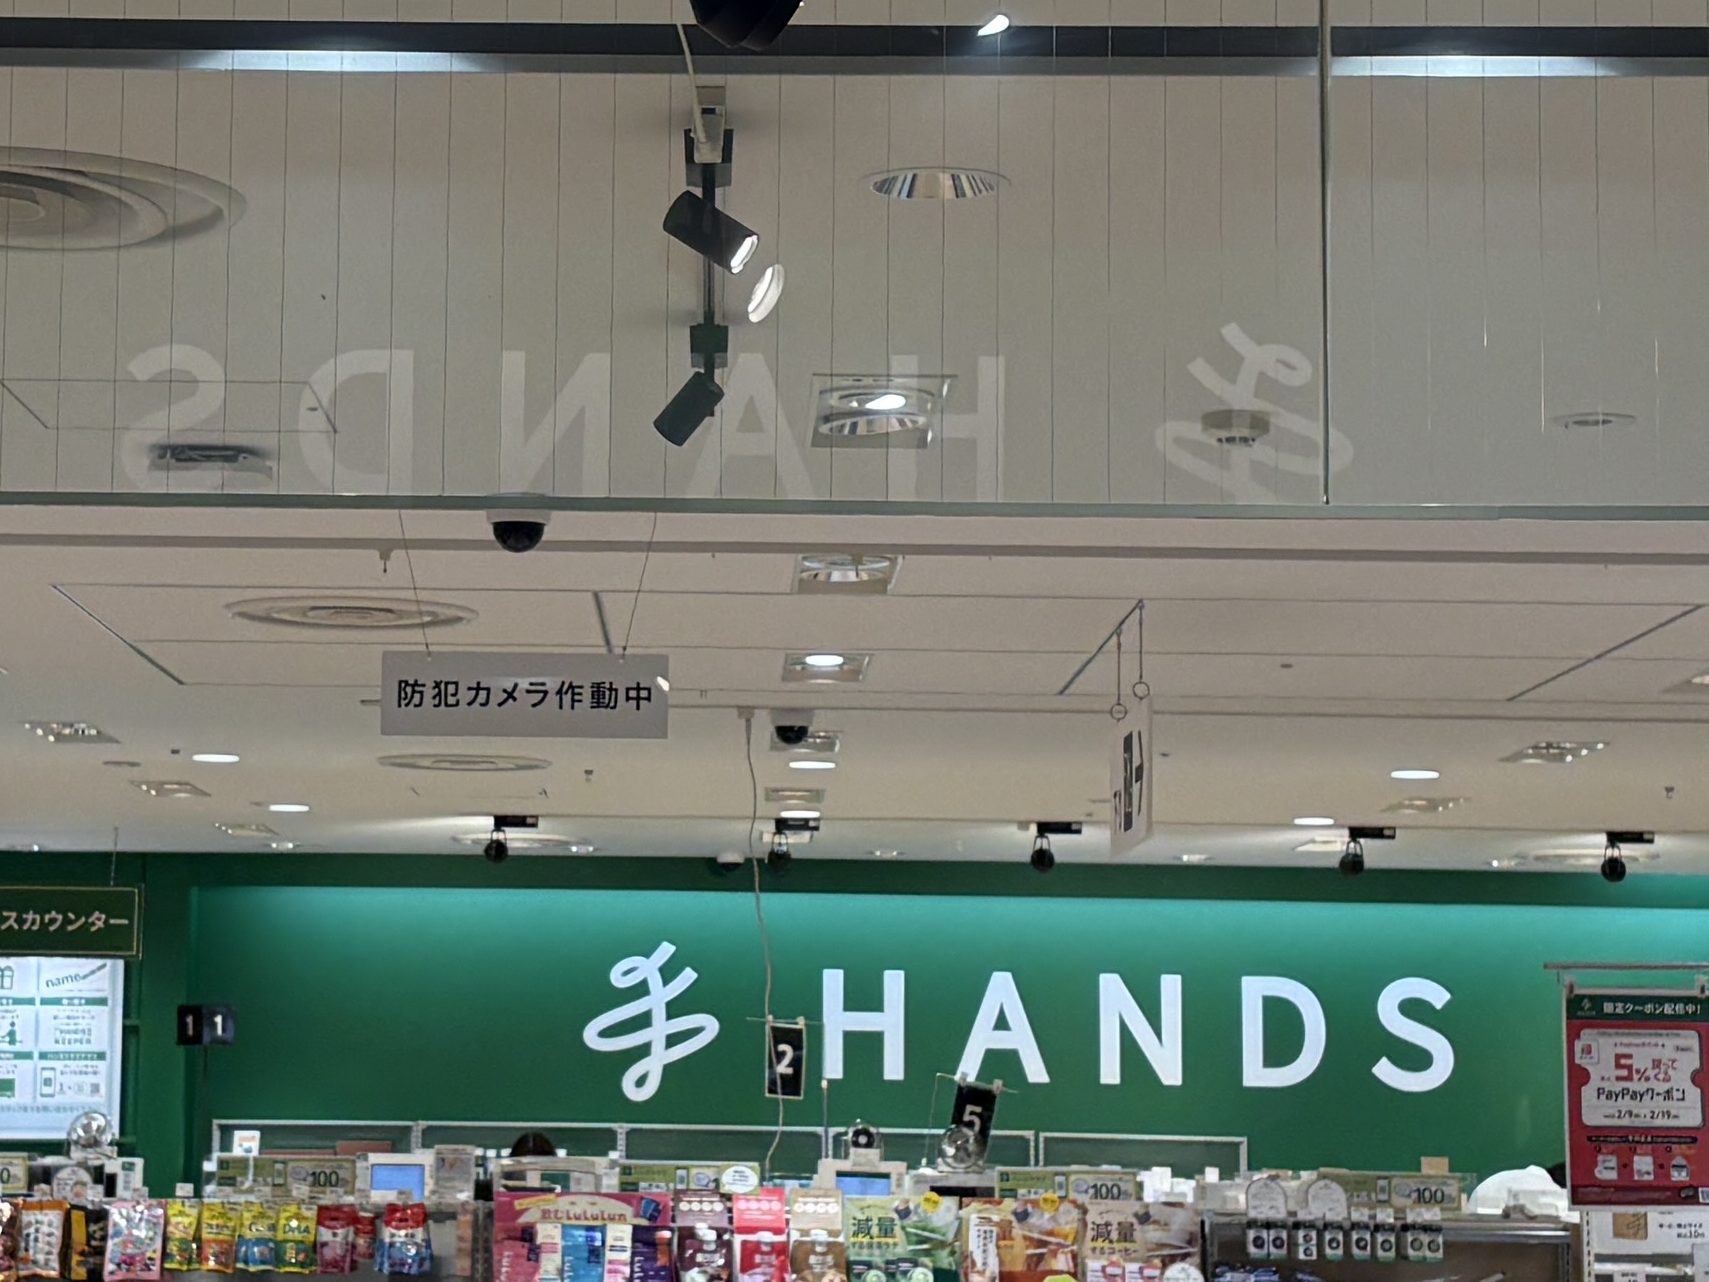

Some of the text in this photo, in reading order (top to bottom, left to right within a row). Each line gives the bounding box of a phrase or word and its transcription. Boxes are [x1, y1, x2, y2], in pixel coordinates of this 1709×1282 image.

[396, 678, 652, 711] 防犯カメラ作動中
[821, 968, 1455, 1093] HANDS
[776, 1043, 794, 1076] 2
[310, 1169, 340, 1187] 100
[1090, 1182, 1121, 1200] 100
[1413, 1186, 1446, 1204] 100
[851, 1215, 898, 1240] 減量
